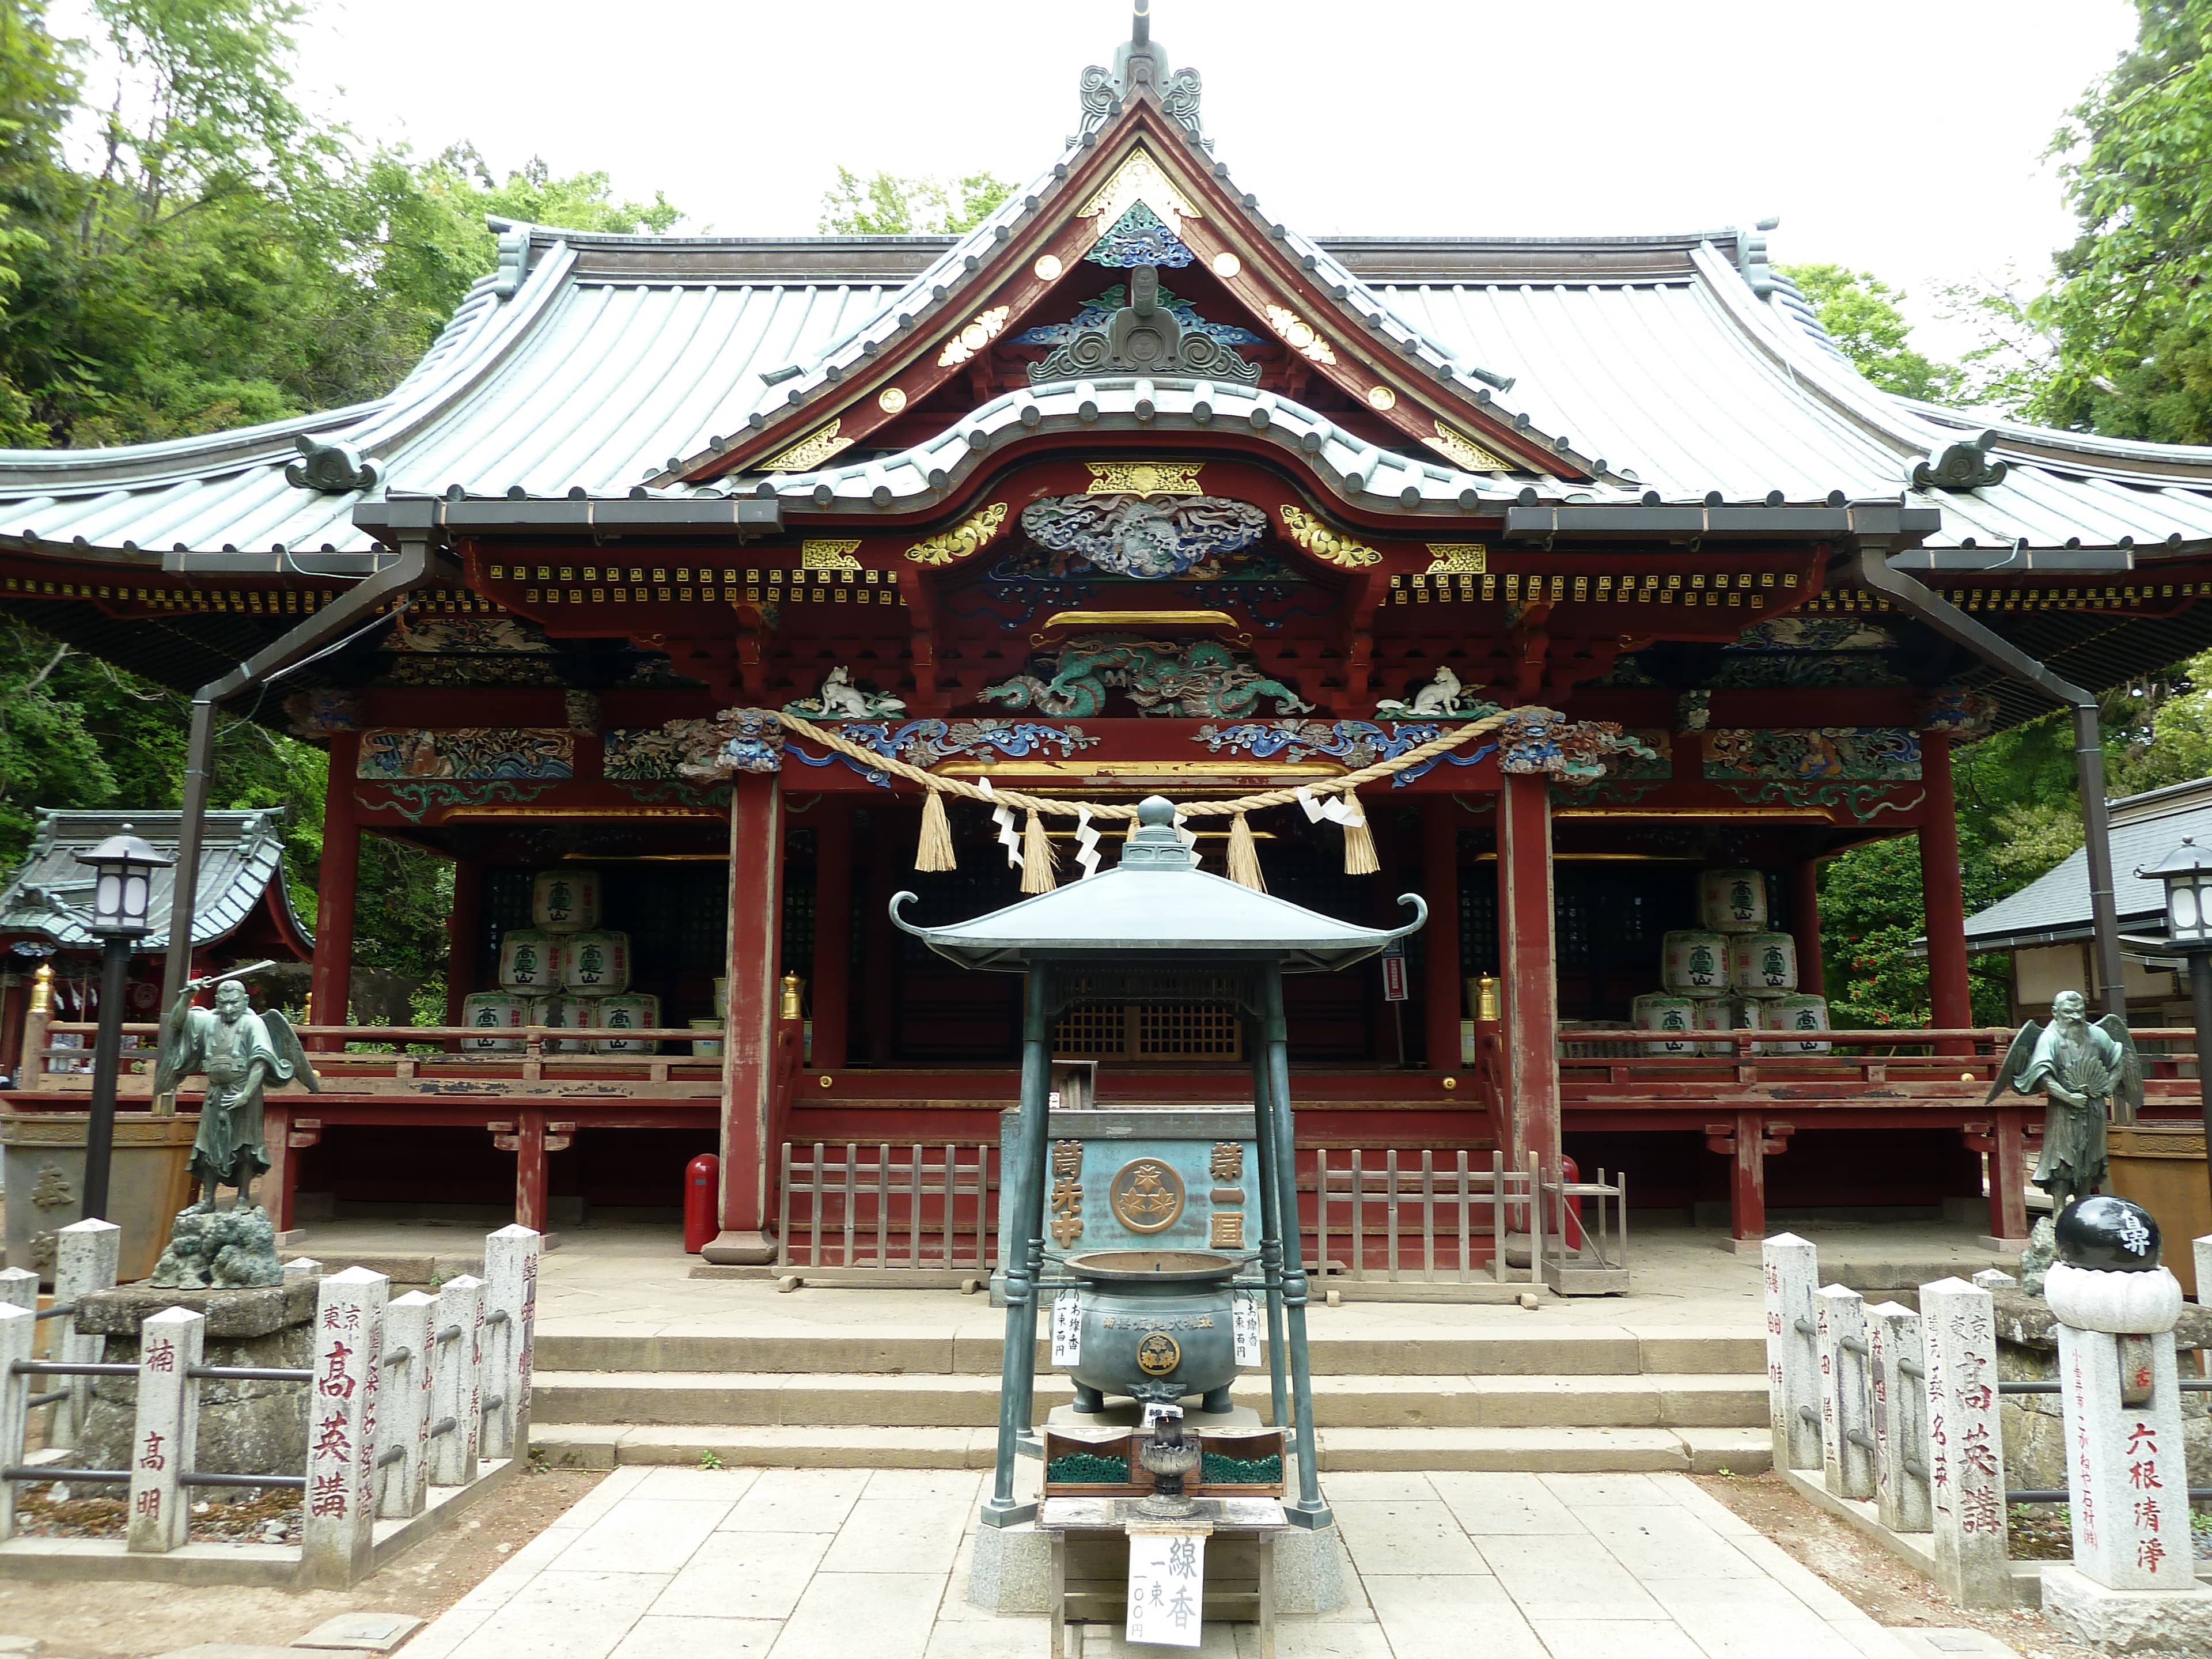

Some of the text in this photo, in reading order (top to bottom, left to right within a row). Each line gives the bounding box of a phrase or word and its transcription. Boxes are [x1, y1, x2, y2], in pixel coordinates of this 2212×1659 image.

[477, 1007, 497, 1048] 高山
[611, 1008, 630, 1048] 高山
[1051, 1140, 1084, 1249] 筒先中
[2119, 1209, 2151, 1257] 鼻
[323, 1303, 362, 1331] 東京
[1949, 1314, 1990, 1343] 東京
[1147, 1560, 1165, 1608] 一束
[1166, 1537, 1198, 1631] 線香
